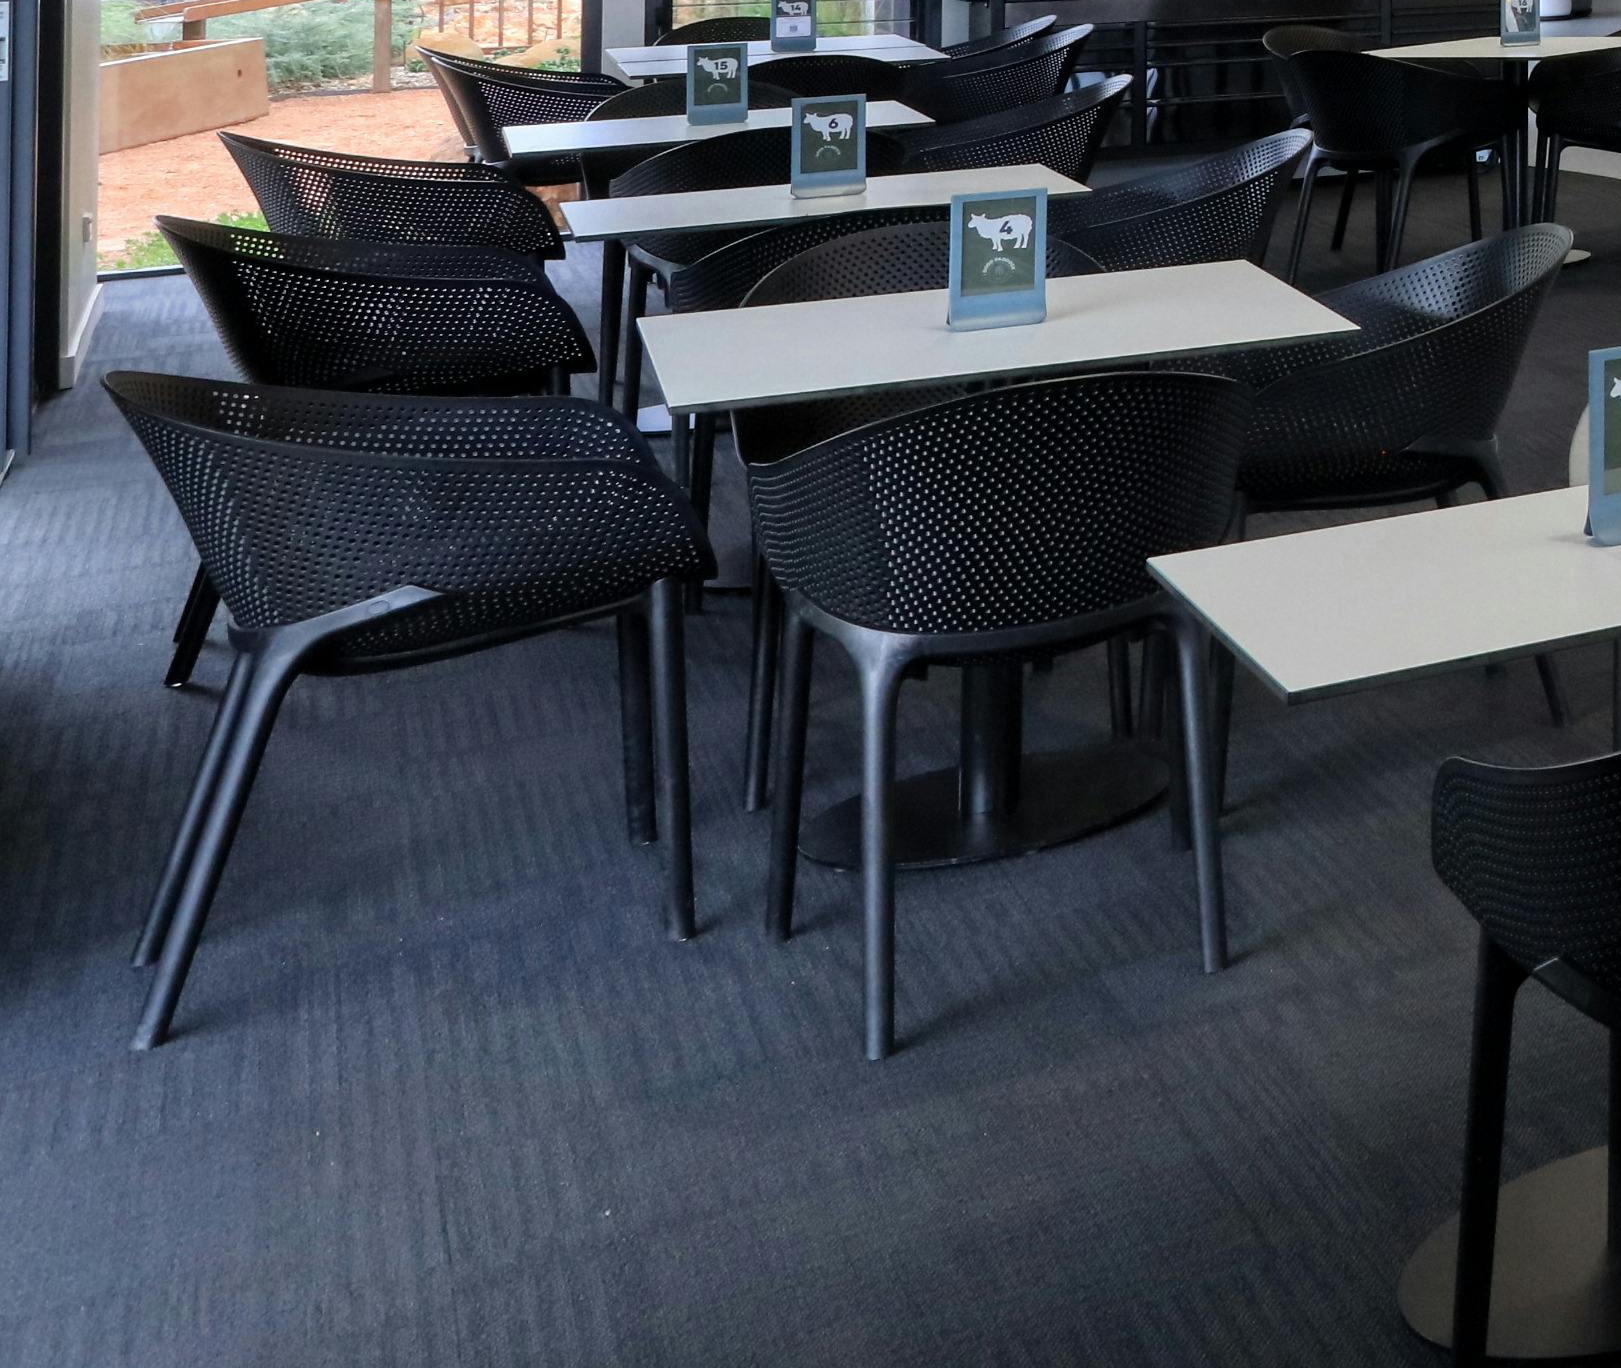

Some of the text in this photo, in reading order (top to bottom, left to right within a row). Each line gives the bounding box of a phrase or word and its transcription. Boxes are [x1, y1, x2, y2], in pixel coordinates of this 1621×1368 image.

[1519, 0, 1528, 7] 16
[714, 61, 728, 70] 15
[829, 118, 839, 129] 6
[999, 220, 1013, 235] 4
